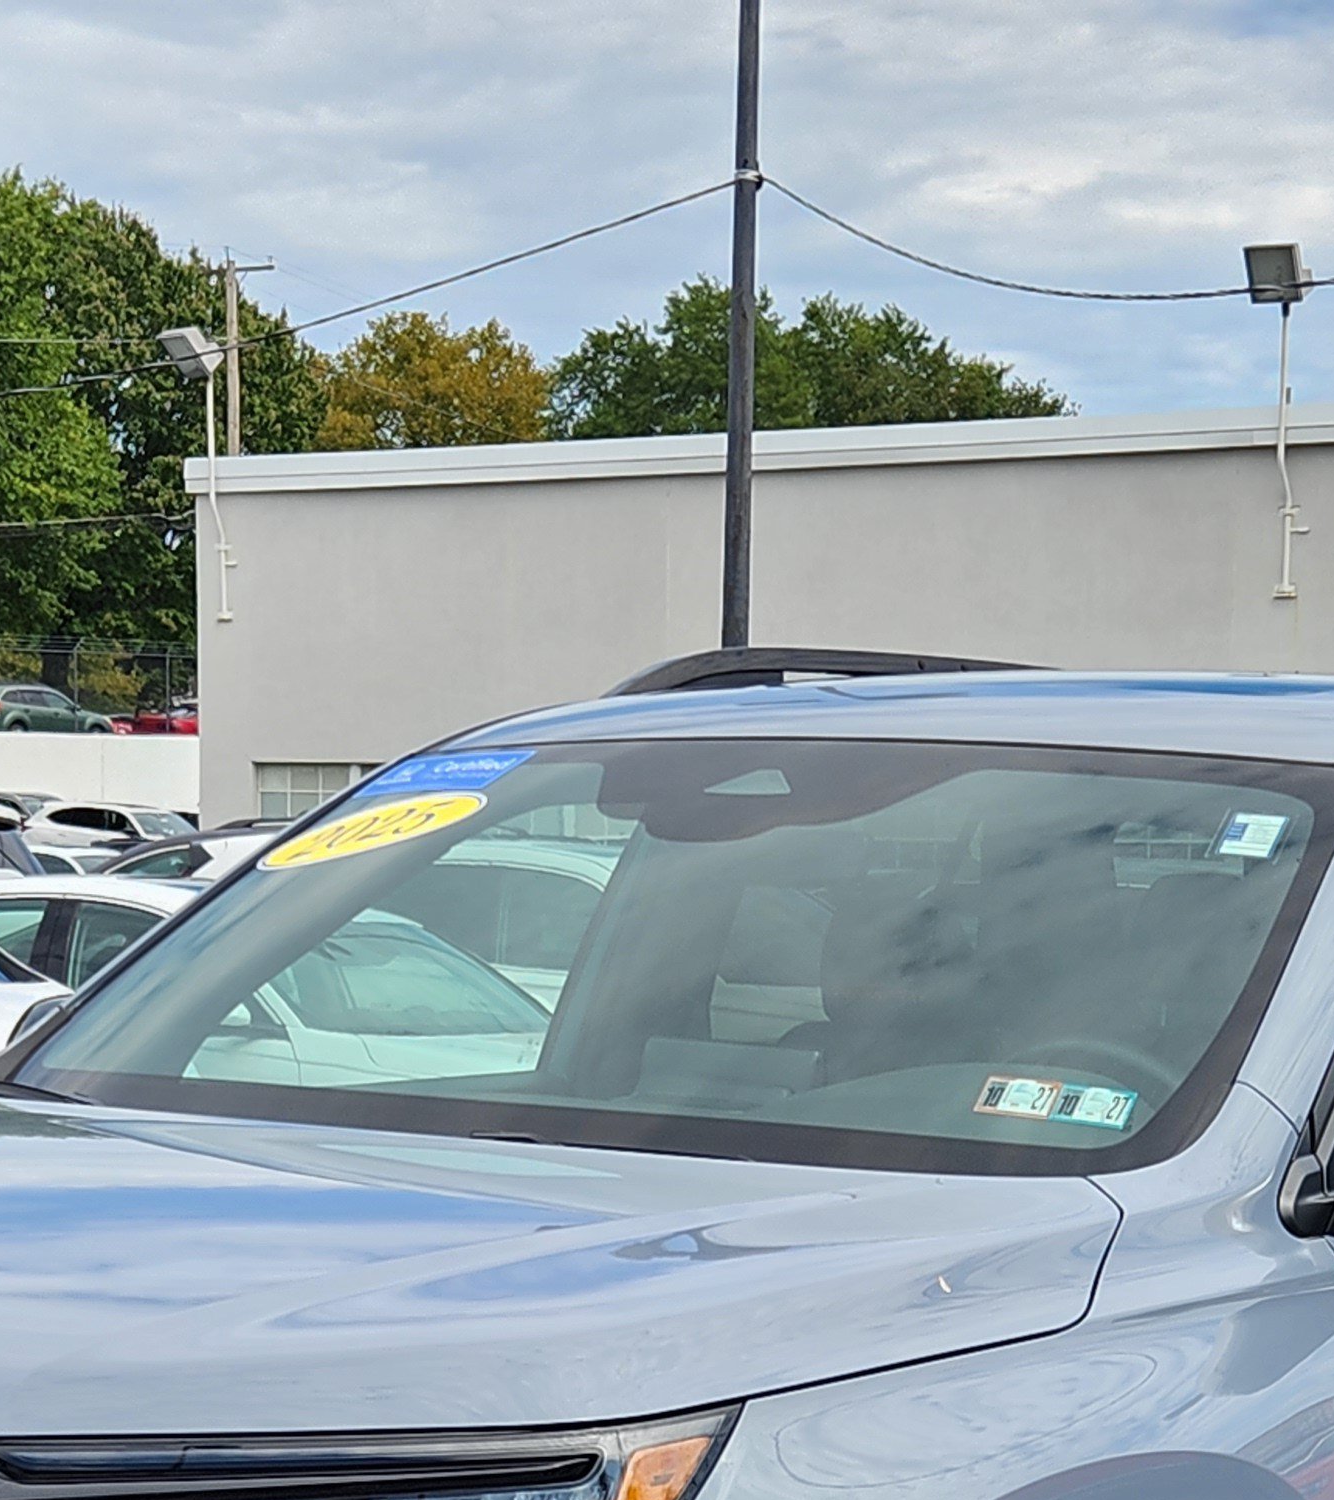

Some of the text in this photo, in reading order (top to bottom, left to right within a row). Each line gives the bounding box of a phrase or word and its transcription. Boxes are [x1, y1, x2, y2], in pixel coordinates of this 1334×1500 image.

[286, 800, 456, 861] 2025
[982, 1086, 1054, 1112] 10 27
[1056, 1094, 1130, 1121] 10 27
